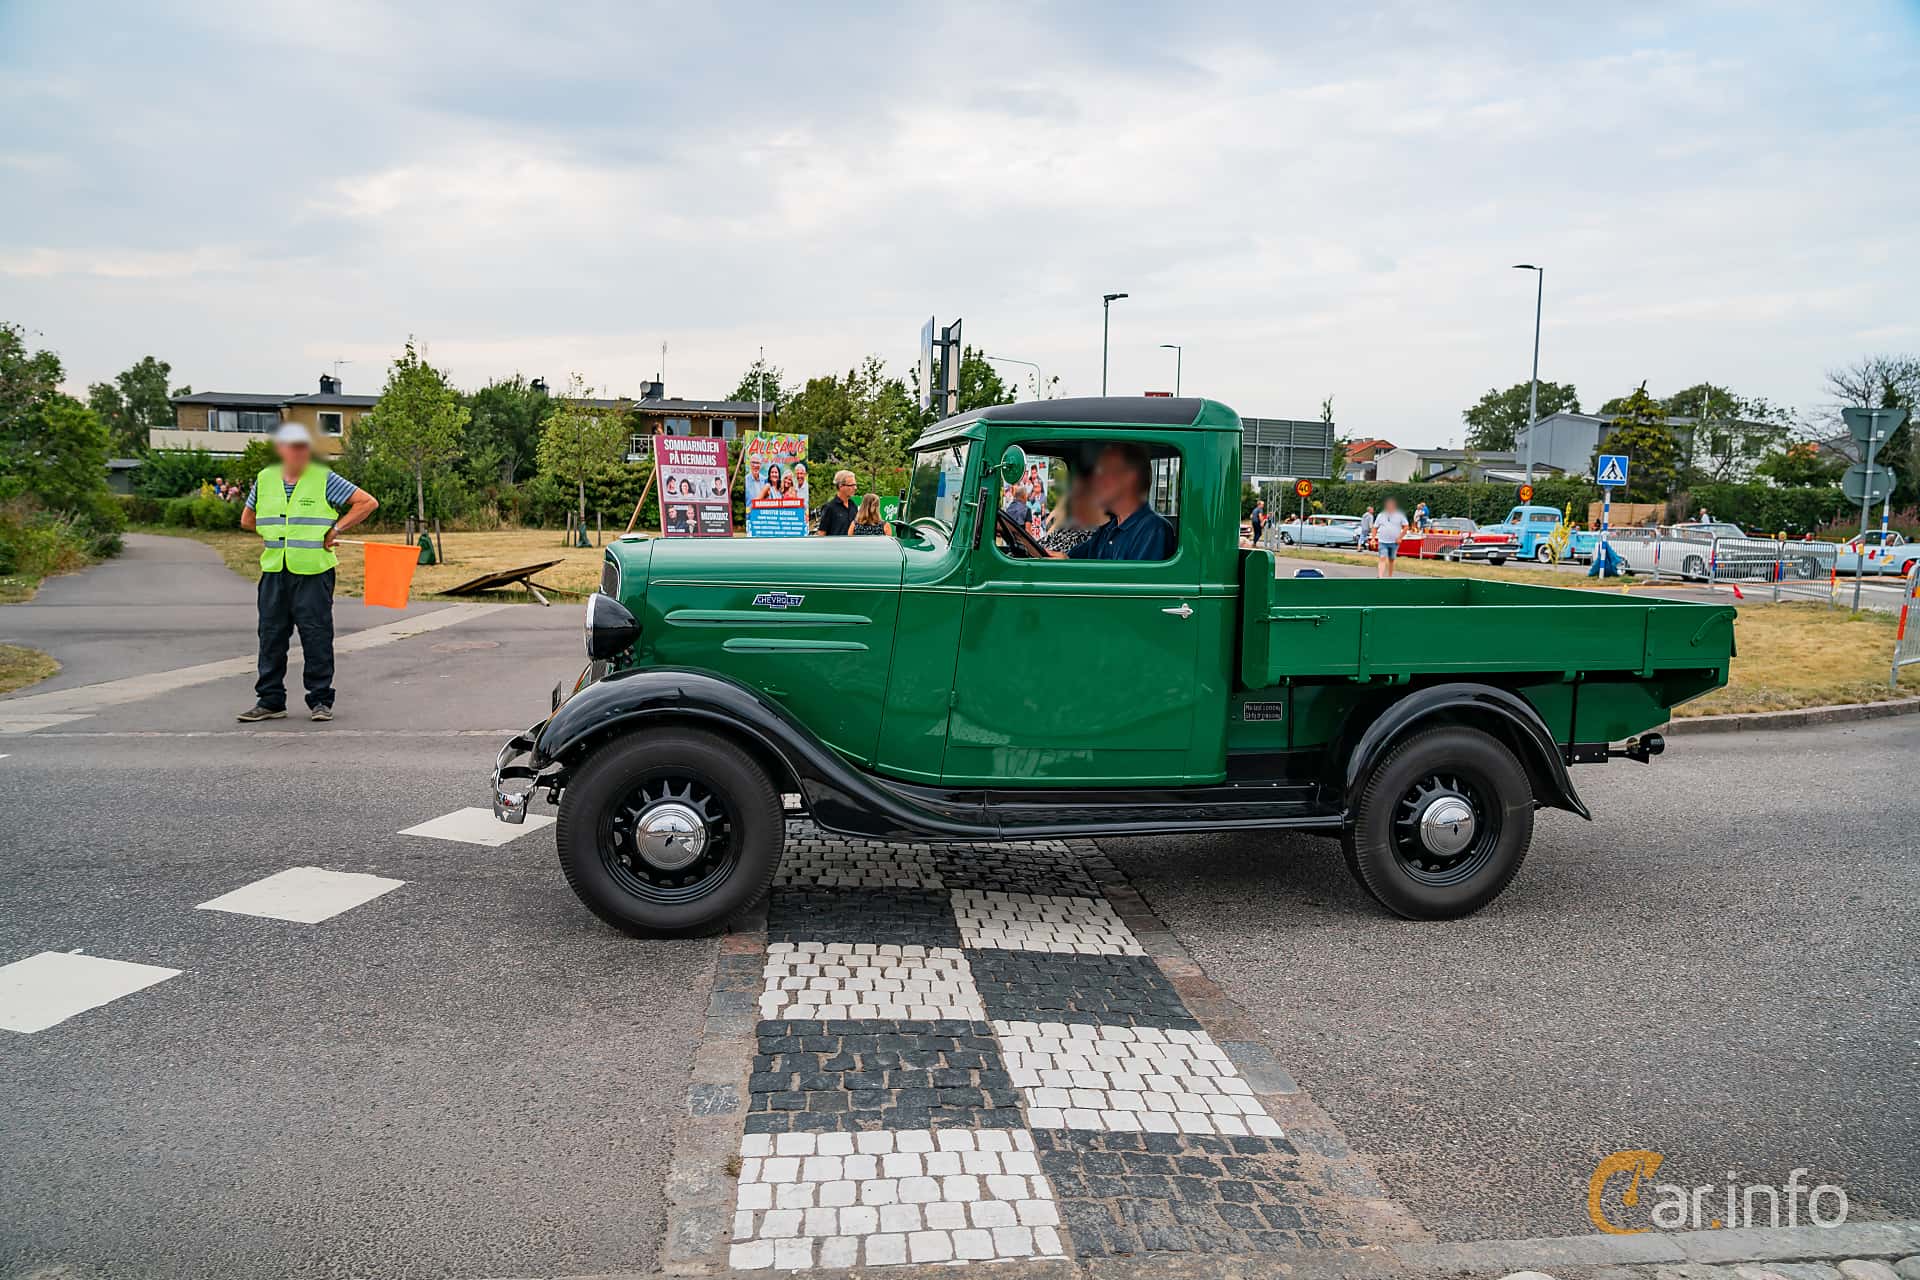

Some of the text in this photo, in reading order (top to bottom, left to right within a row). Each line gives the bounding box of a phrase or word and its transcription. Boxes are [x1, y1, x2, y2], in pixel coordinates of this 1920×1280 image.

[664, 439, 720, 453] SOMMARNÖJEN
[669, 451, 717, 466] PÅ HERMANS
[1299, 483, 1309, 493] 40
[1521, 489, 1530, 497] 40
[757, 596, 801, 605] CHEVROLET
